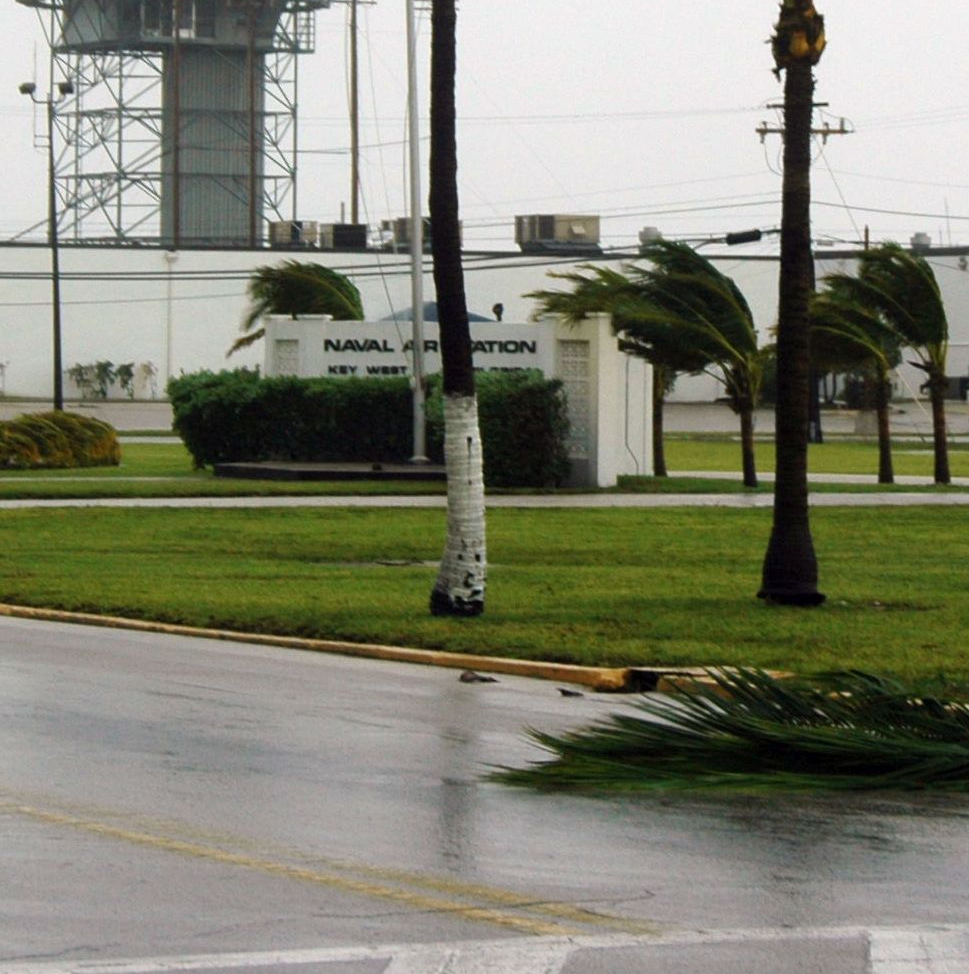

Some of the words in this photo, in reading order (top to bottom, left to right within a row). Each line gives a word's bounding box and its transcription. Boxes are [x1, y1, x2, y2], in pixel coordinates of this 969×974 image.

[324, 339, 394, 352] NAVAL
[402, 339, 439, 352] AR
[328, 365, 357, 374] KEY
[366, 366, 407, 374] WEST
